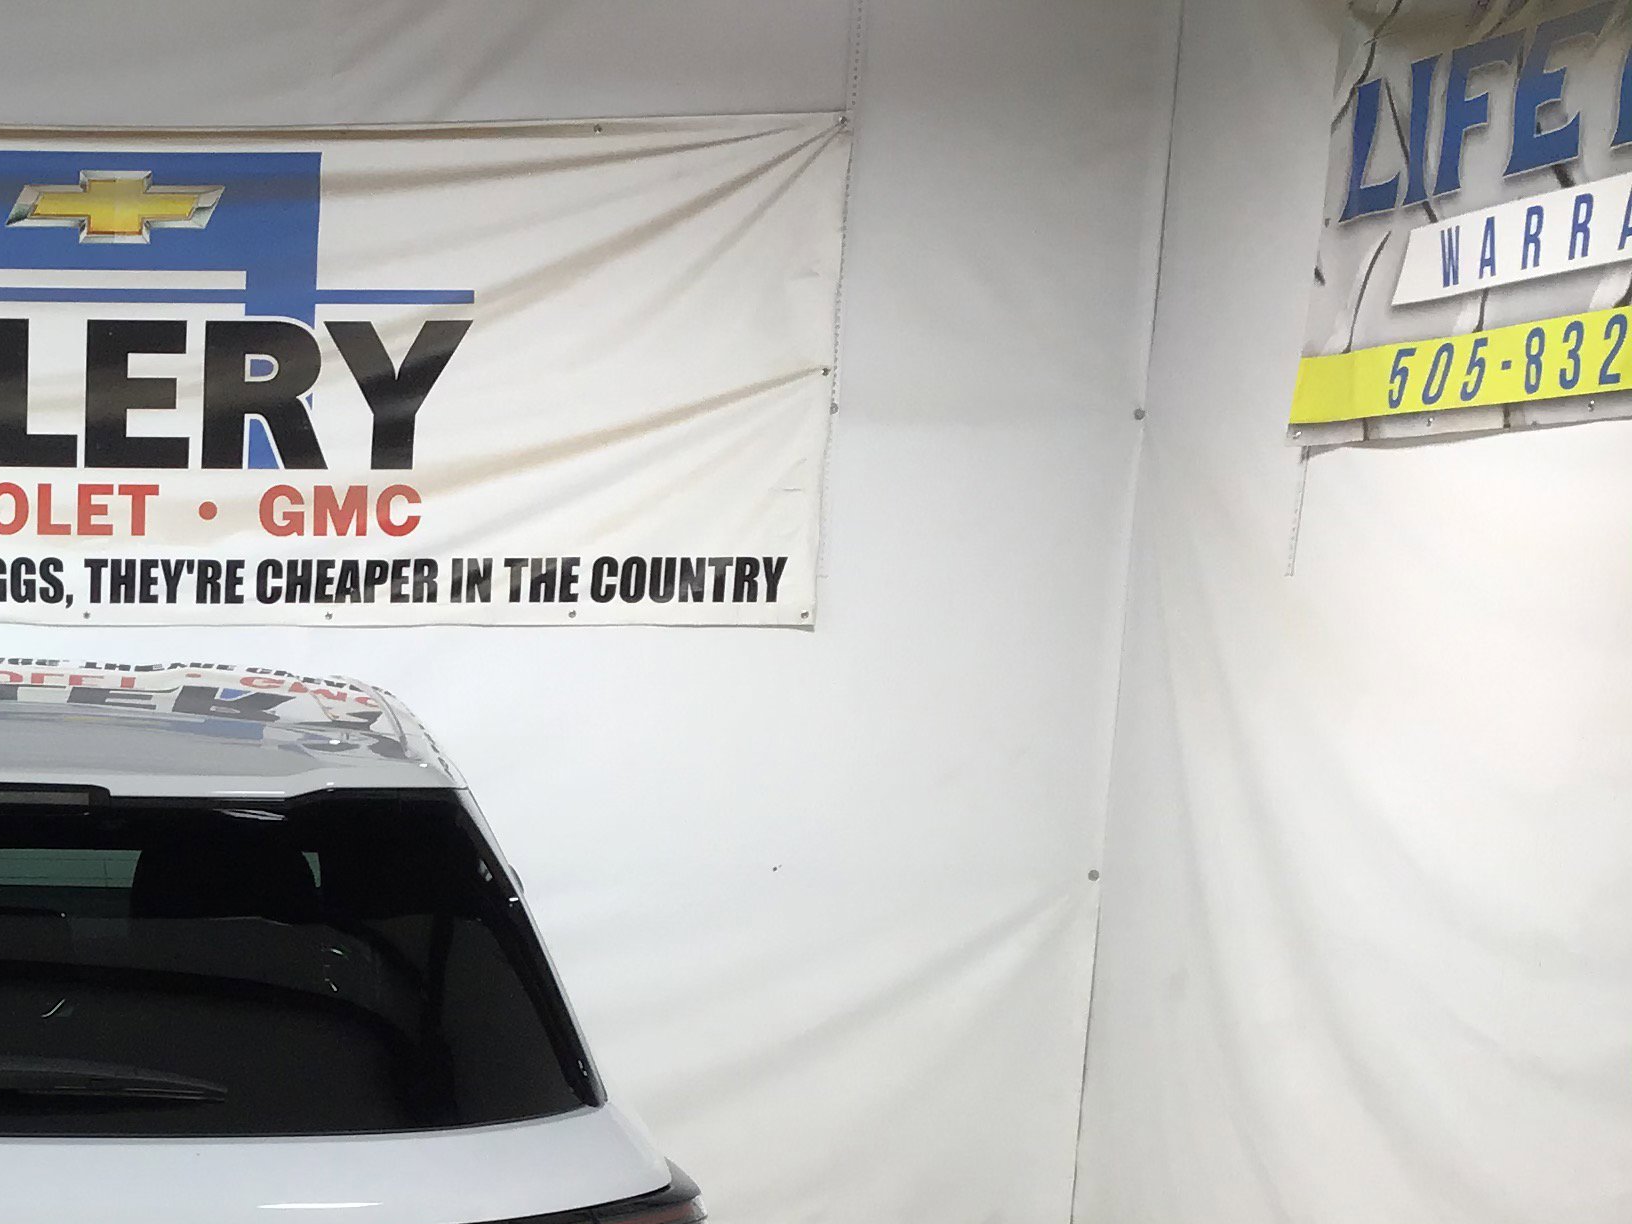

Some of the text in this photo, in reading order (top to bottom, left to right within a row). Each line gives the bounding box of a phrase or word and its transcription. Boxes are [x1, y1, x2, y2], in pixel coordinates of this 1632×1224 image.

[1338, 0, 1632, 223] LIFE
[1388, 313, 1628, 409] 505-832
[258, 483, 423, 538] GMC
[83, 557, 246, 605] THEY'RE
[255, 557, 439, 605] CHEAPER
[449, 557, 494, 604] IN
[503, 556, 582, 604] THE
[589, 555, 789, 604] COUNTRY
